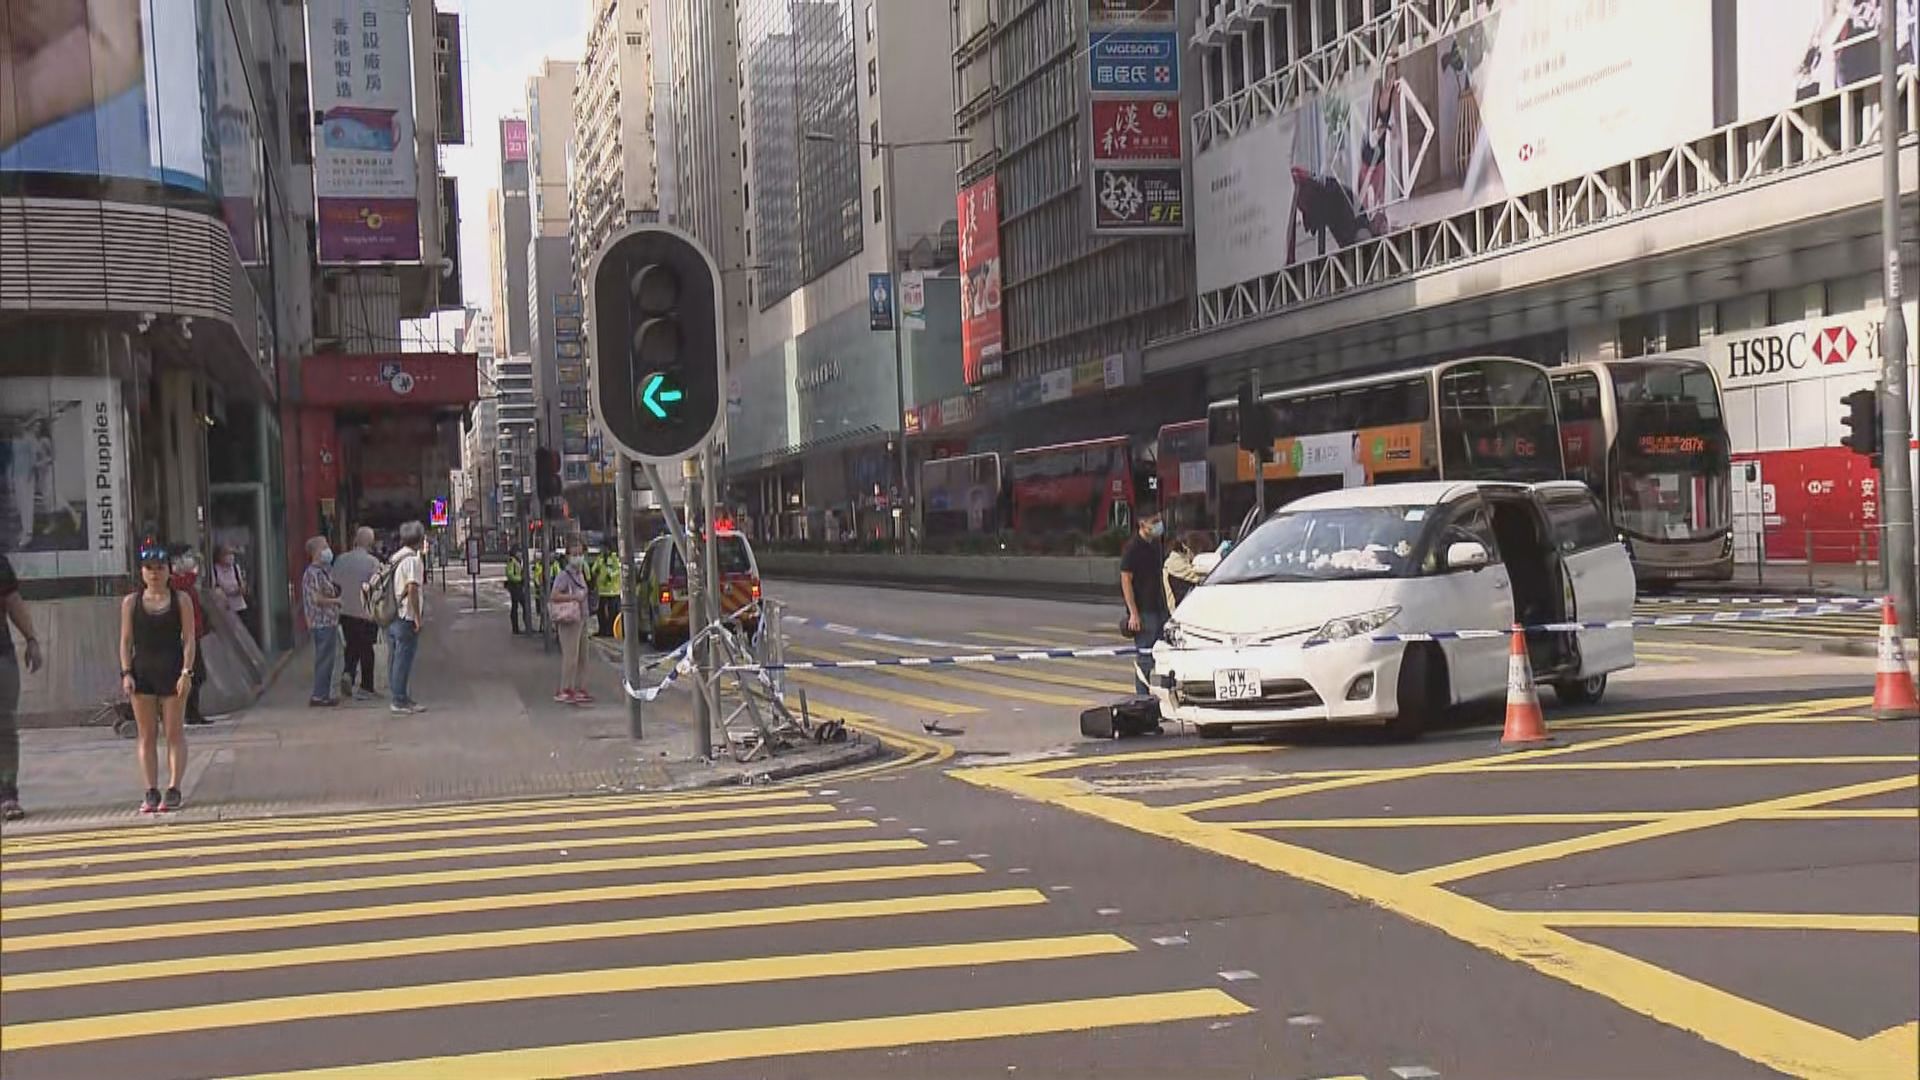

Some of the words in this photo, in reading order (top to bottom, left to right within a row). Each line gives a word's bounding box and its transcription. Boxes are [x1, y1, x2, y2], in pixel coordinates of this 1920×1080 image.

[332, 18, 352, 97] 香港製造
[1105, 43, 1160, 54] watsons
[1097, 65, 1147, 83] 屈臣氏
[1727, 331, 1808, 379] HSBC
[93, 401, 113, 490] Puppies
[97, 495, 114, 550] Hush
[1219, 681, 1257, 699] 2875
[1227, 670, 1245, 684] WW
